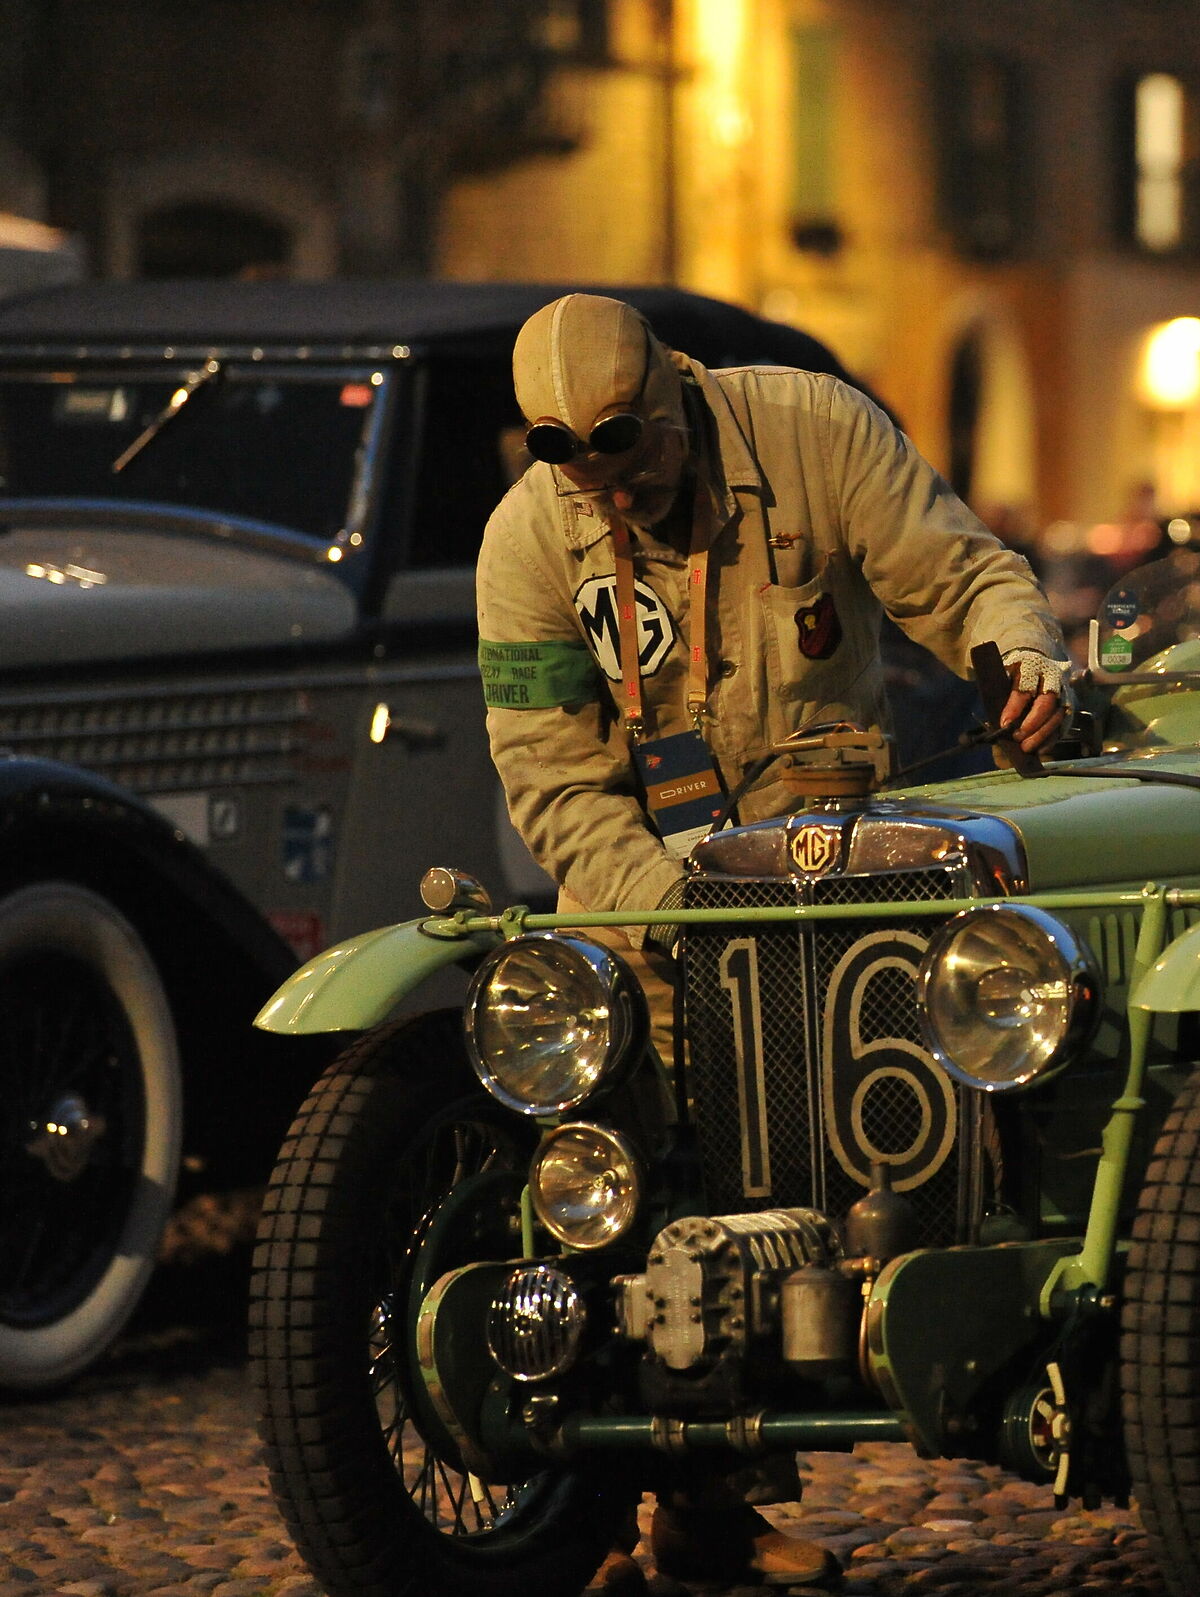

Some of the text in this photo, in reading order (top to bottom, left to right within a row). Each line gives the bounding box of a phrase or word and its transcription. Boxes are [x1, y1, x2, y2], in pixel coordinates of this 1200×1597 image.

[578, 584, 664, 672] MG
[481, 648, 542, 661] TERNATIONAL
[511, 667, 537, 680] RACE
[486, 684, 530, 703] DRIVER
[660, 781, 707, 799] DRIVER
[795, 830, 826, 868] MG
[719, 929, 957, 1198] 16
